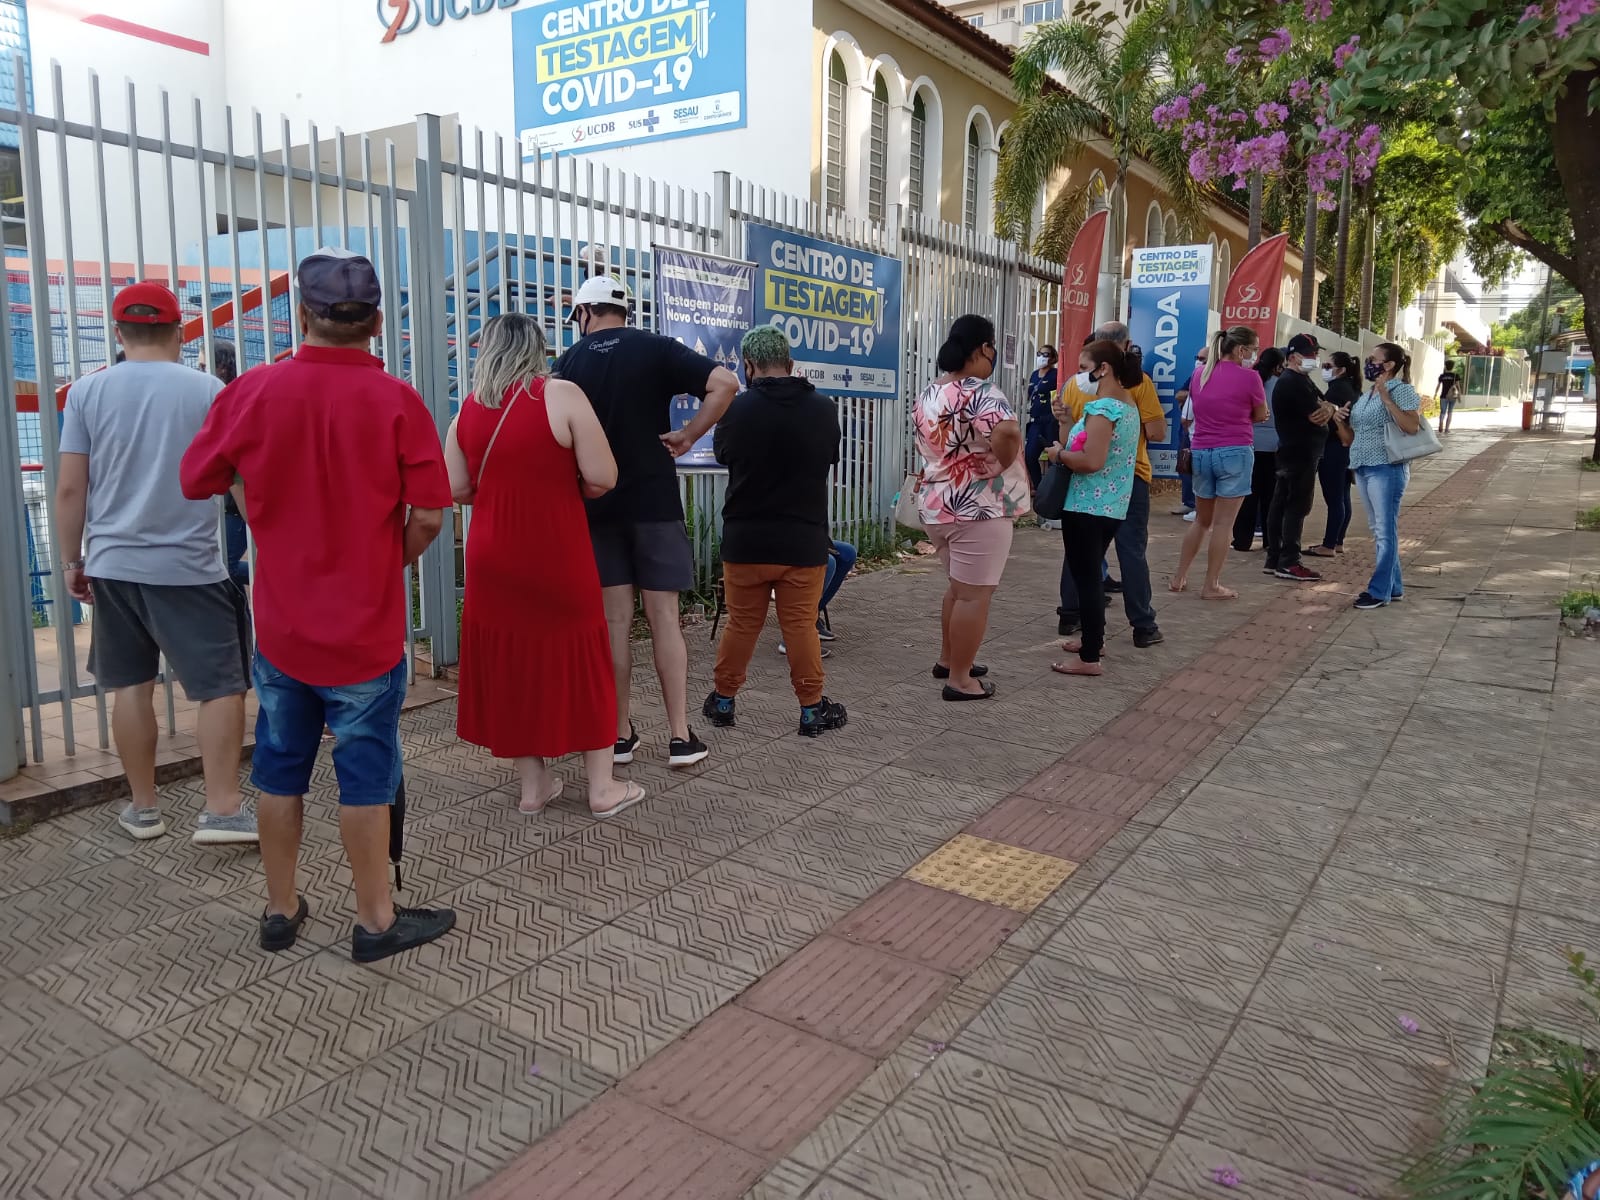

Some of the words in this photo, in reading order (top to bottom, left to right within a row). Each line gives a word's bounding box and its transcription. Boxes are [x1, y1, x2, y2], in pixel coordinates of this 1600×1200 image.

[542, 0, 645, 39] CENTRO
[541, 15, 693, 77] TESTAGEM
[542, 55, 693, 116] COVID-19
[673, 105, 699, 119] SESAU
[587, 122, 616, 136] UCDB
[628, 119, 642, 129] SUS
[1140, 250, 1182, 261] CENTRO
[1183, 250, 1198, 259] DE
[770, 240, 847, 280] CENTRO
[851, 258, 874, 287] DE
[1138, 260, 1199, 272] TESTAGEM
[1138, 271, 1198, 284] COVID-19
[664, 291, 711, 311] Testagem
[713, 302, 735, 314] para
[737, 305, 743, 314] o
[770, 274, 875, 320] TESTAGEM
[1064, 287, 1090, 307] UCDB
[666, 308, 691, 322] Novo
[1225, 305, 1271, 320] UCDB
[804, 368, 825, 379] UCDB
[832, 373, 842, 381] SUS
